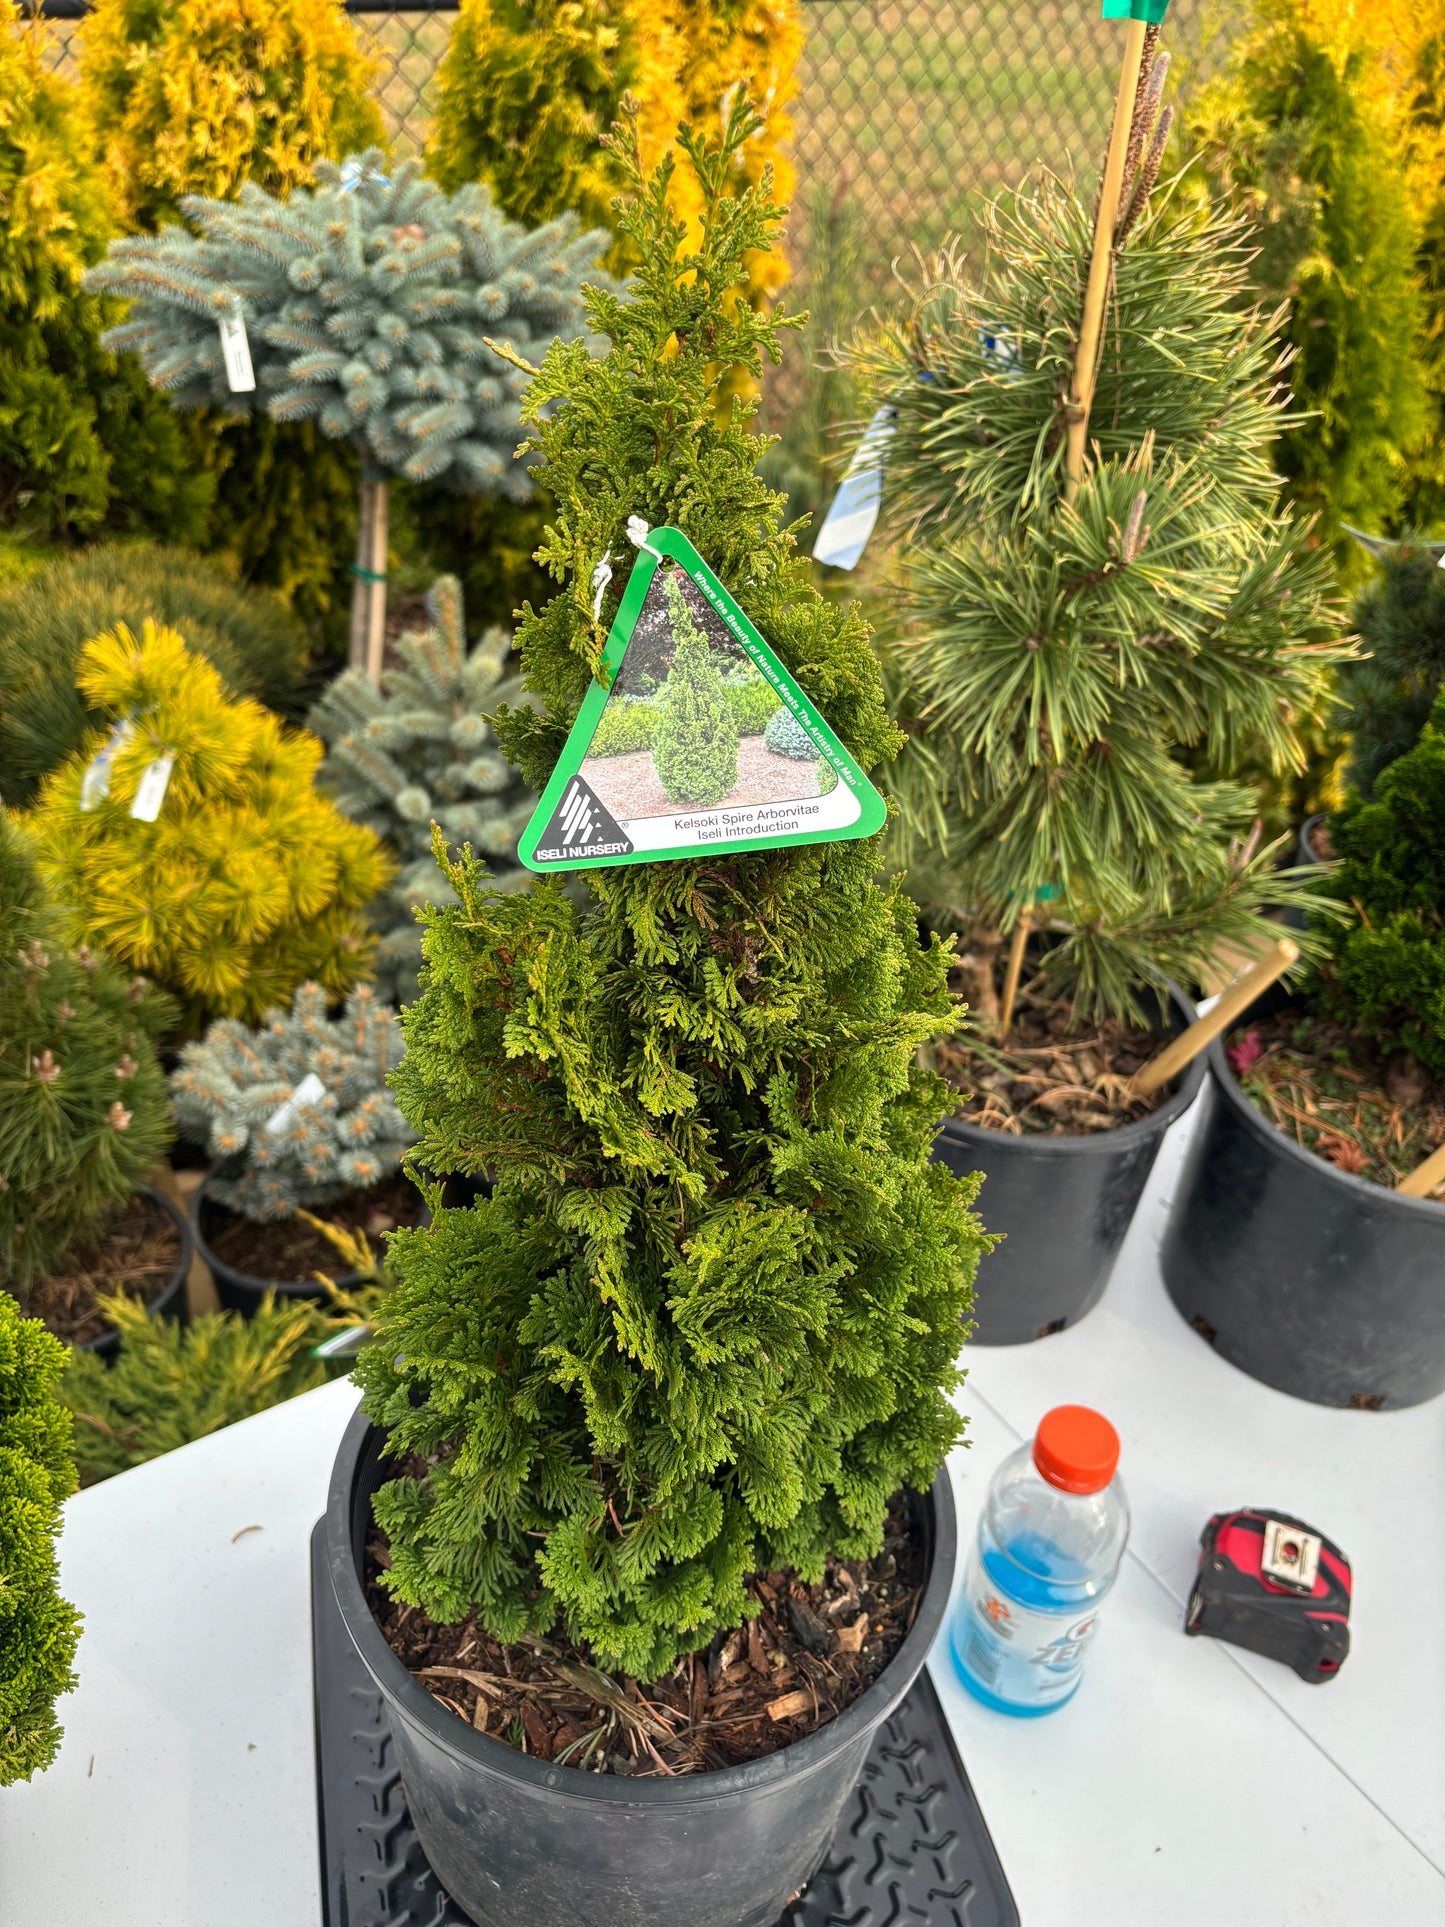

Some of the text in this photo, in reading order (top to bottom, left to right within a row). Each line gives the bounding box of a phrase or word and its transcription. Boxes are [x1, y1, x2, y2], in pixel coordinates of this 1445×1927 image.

[694, 571, 857, 786] Where the Beauty of Nature Meets The Artistry of Man
[674, 804, 820, 830] Kelsoki Spire Arborvitae
[698, 820, 799, 840] Iseli Introduction
[536, 842, 629, 861] ISELI NURSERY
